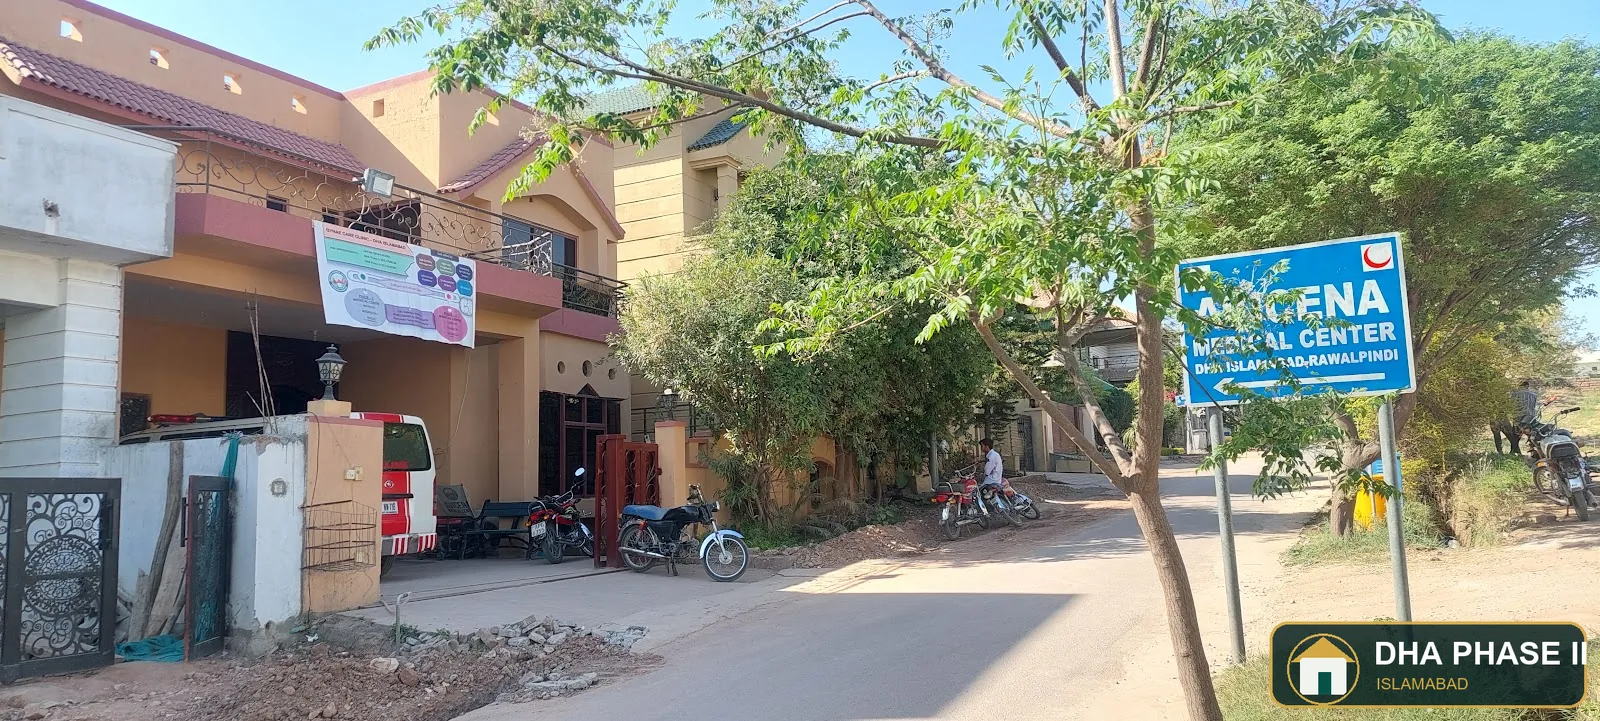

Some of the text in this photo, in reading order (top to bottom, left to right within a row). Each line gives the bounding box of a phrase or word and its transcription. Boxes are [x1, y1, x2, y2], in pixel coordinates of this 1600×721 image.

[383, 241, 406, 250] ISLAMABAD
[1192, 278, 1390, 328] ACENA
[1299, 322, 1396, 348] CENTER
